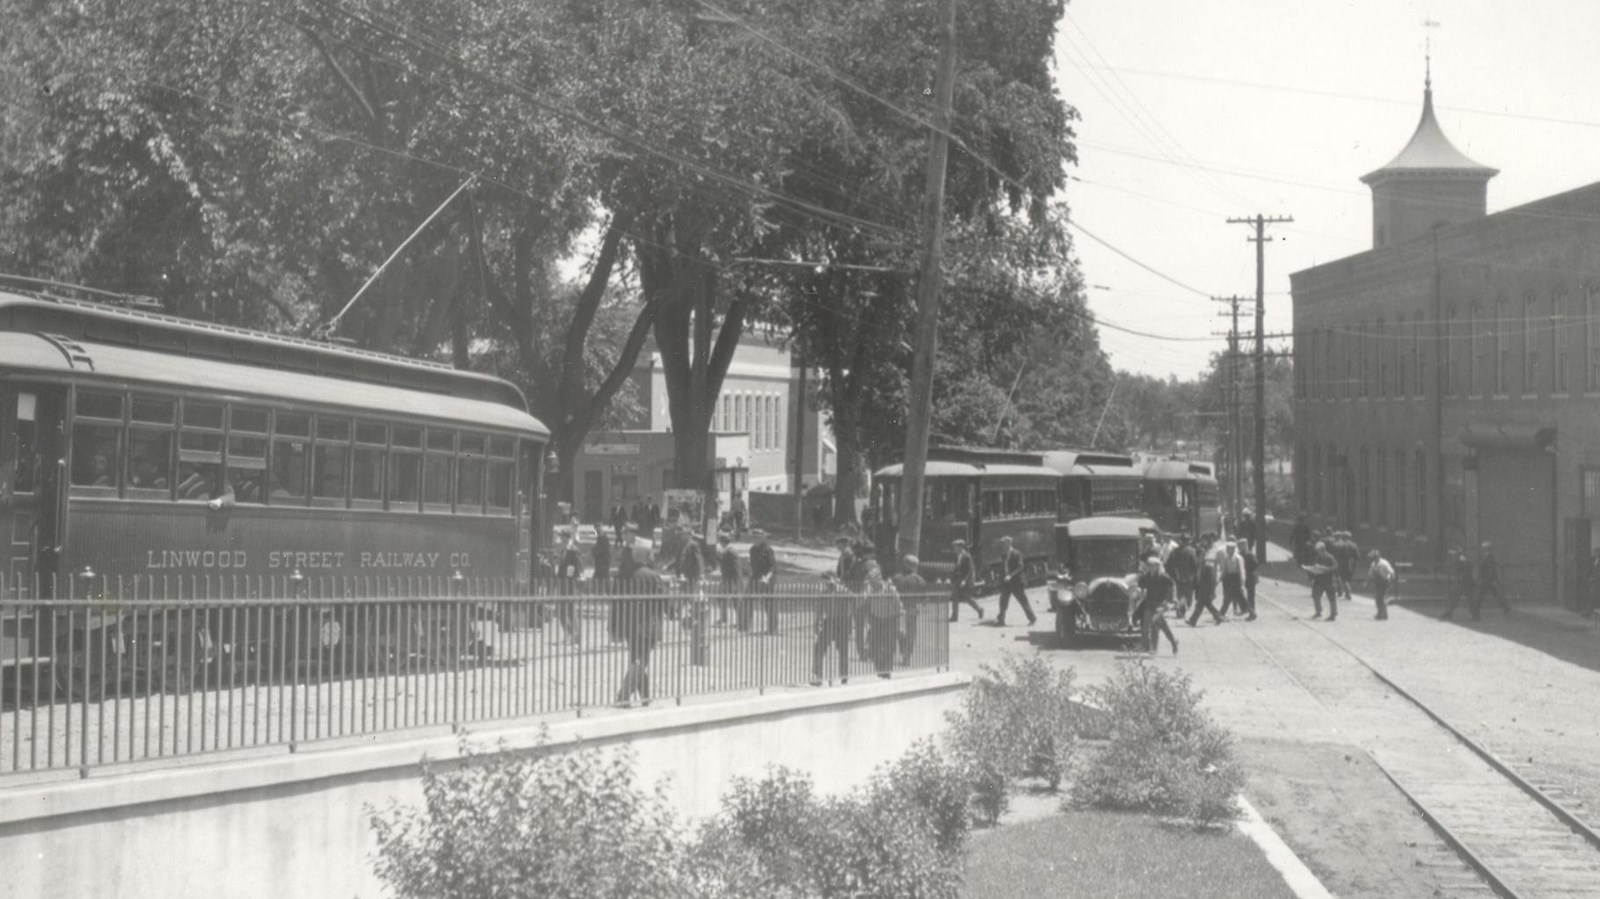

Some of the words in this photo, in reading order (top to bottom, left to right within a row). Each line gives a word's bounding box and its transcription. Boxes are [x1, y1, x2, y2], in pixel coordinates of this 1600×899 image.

[147, 550, 247, 568] LINWOOD
[268, 551, 344, 568] STREET
[360, 552, 440, 568] RAILWAY
